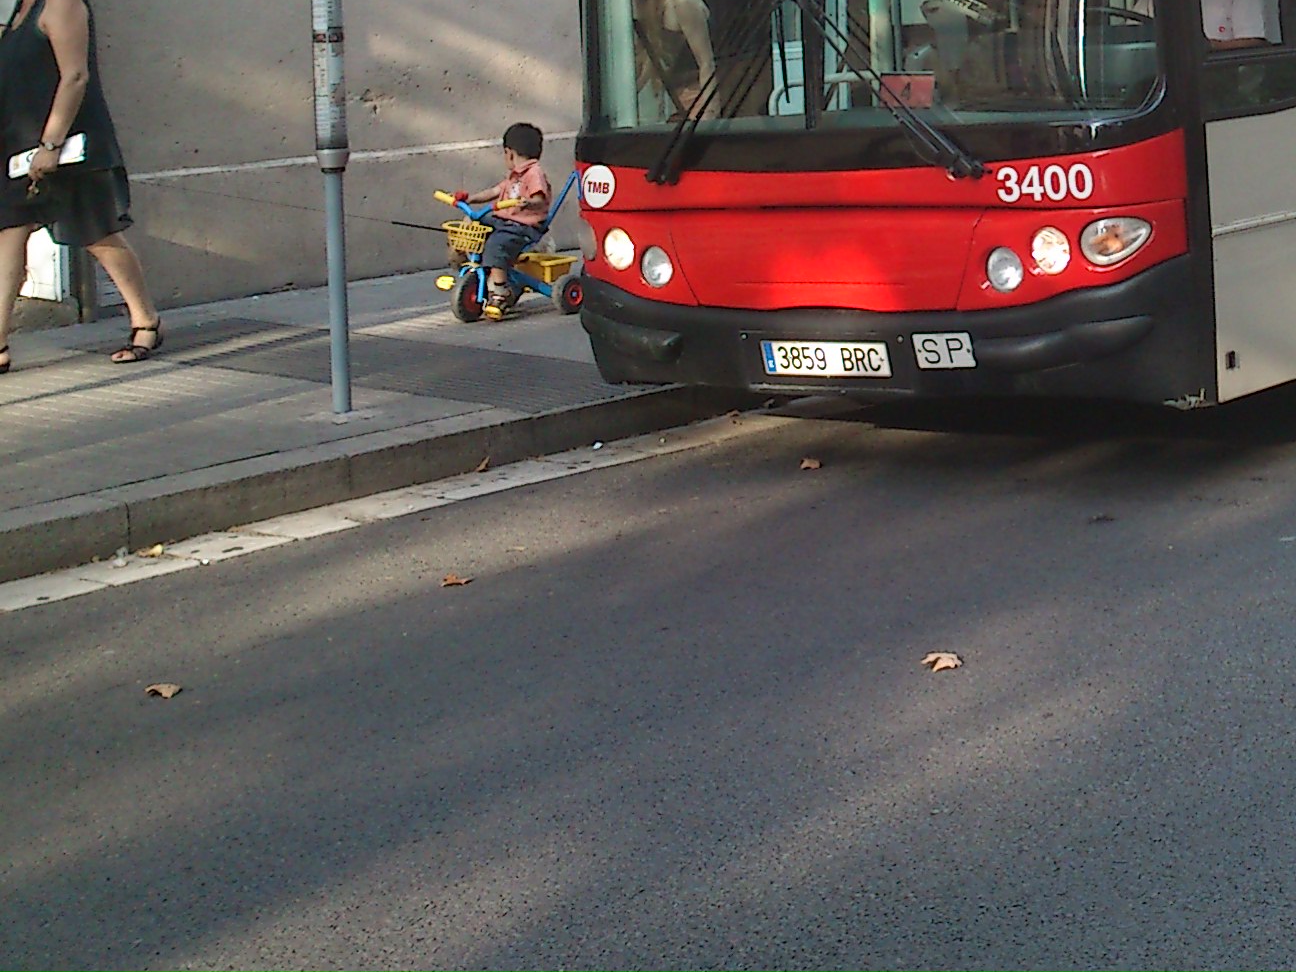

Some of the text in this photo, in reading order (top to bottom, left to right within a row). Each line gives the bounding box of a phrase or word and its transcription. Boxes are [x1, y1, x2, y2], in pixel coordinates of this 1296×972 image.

[586, 180, 610, 196] TMB
[996, 163, 1094, 203] 3400
[777, 346, 882, 373] 3859 BRC
